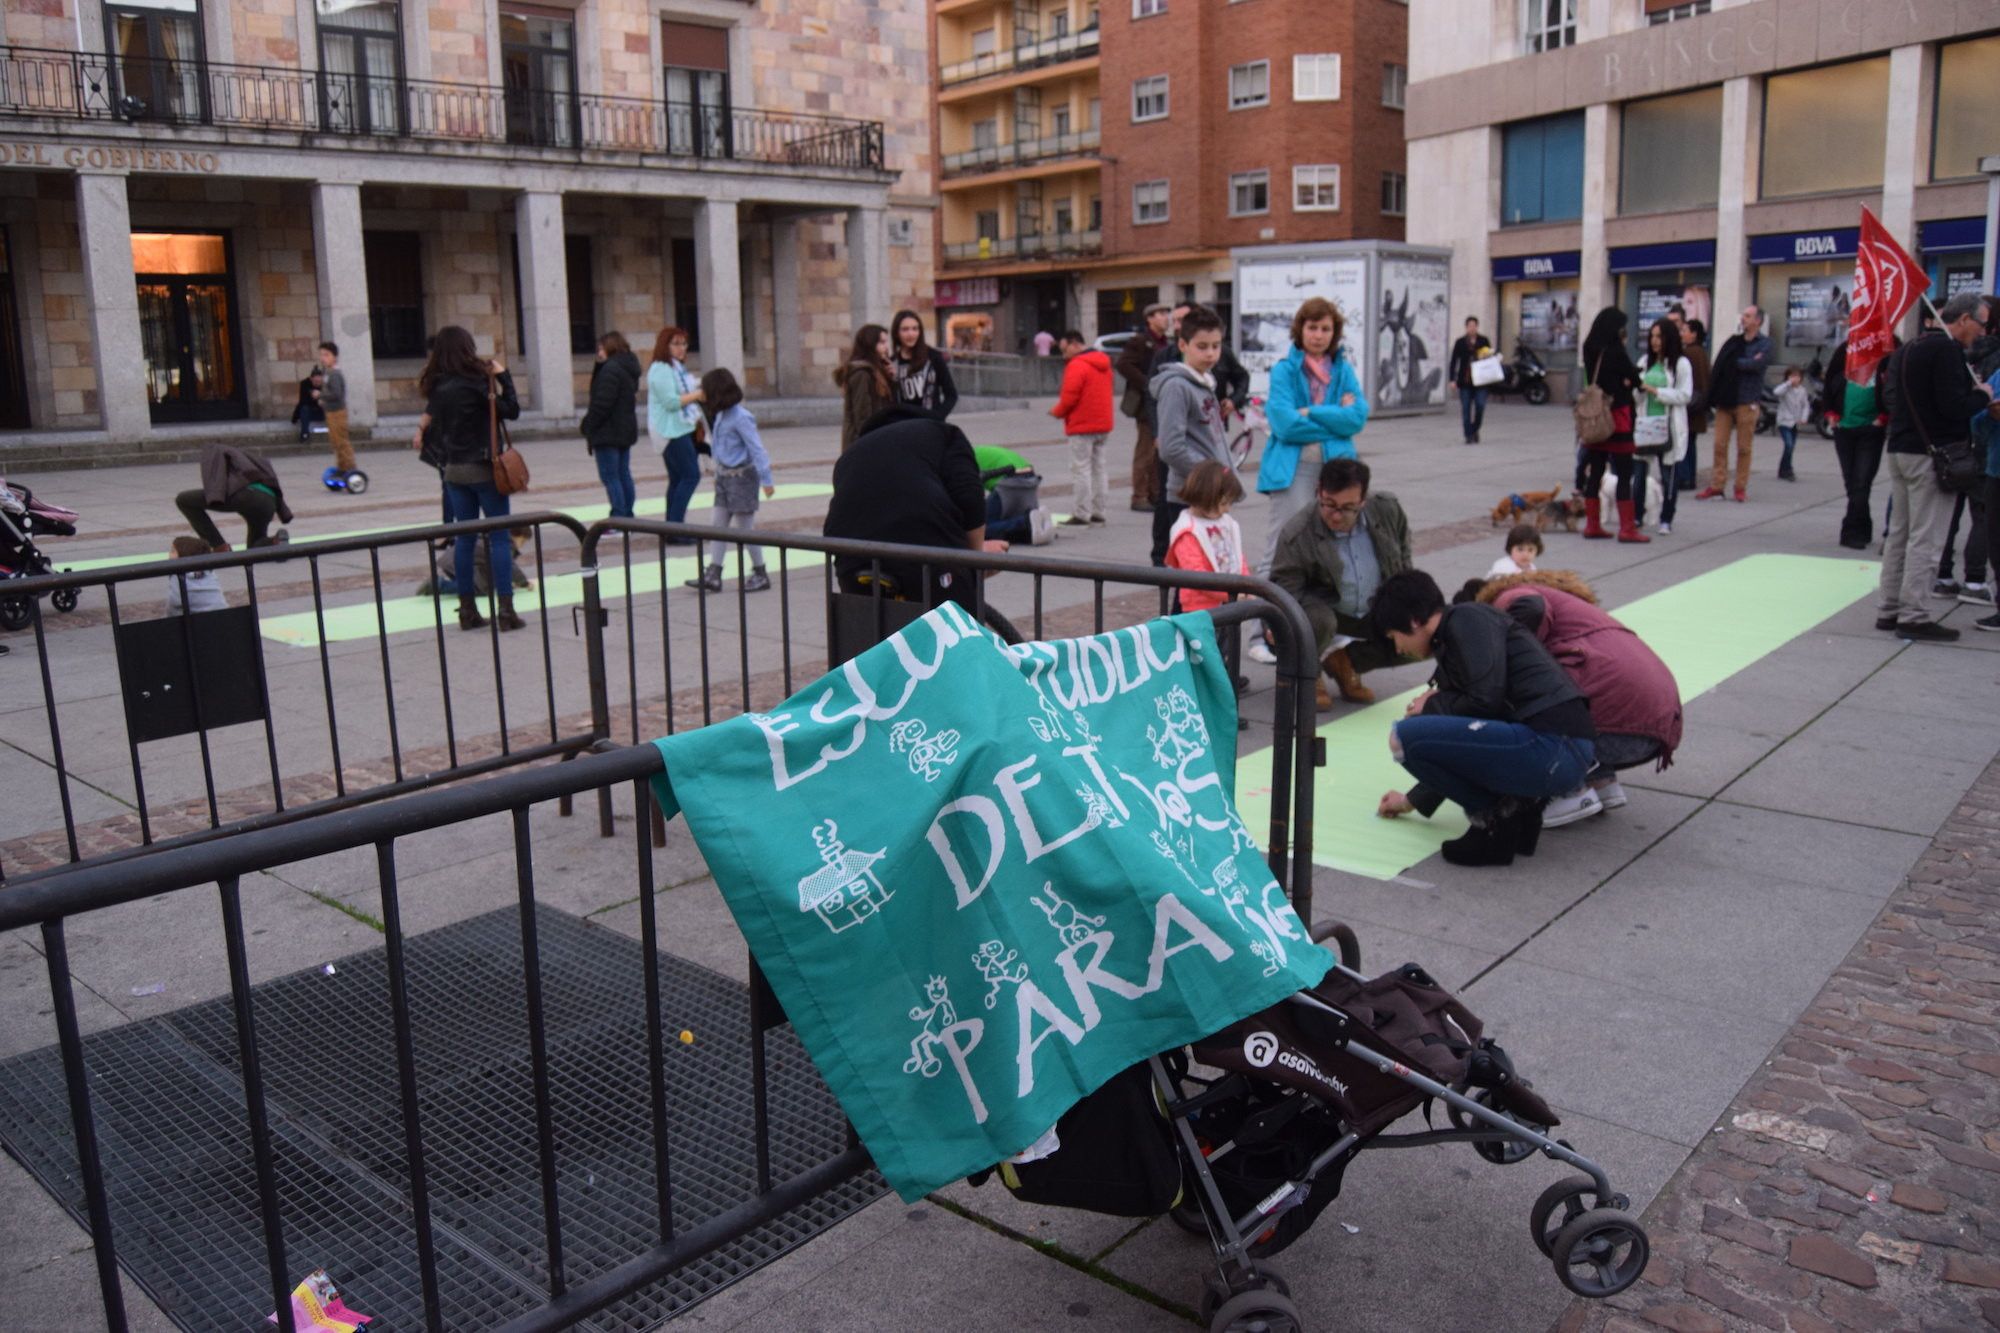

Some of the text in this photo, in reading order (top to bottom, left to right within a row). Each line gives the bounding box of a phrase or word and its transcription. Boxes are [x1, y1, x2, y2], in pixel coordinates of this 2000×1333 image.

[64, 146, 221, 173] GOBIERNO
[1795, 236, 1837, 256] BBVA
[1523, 257, 1554, 275] BBVA
[926, 753, 1101, 912] DE
[941, 892, 1236, 1126] PARA
